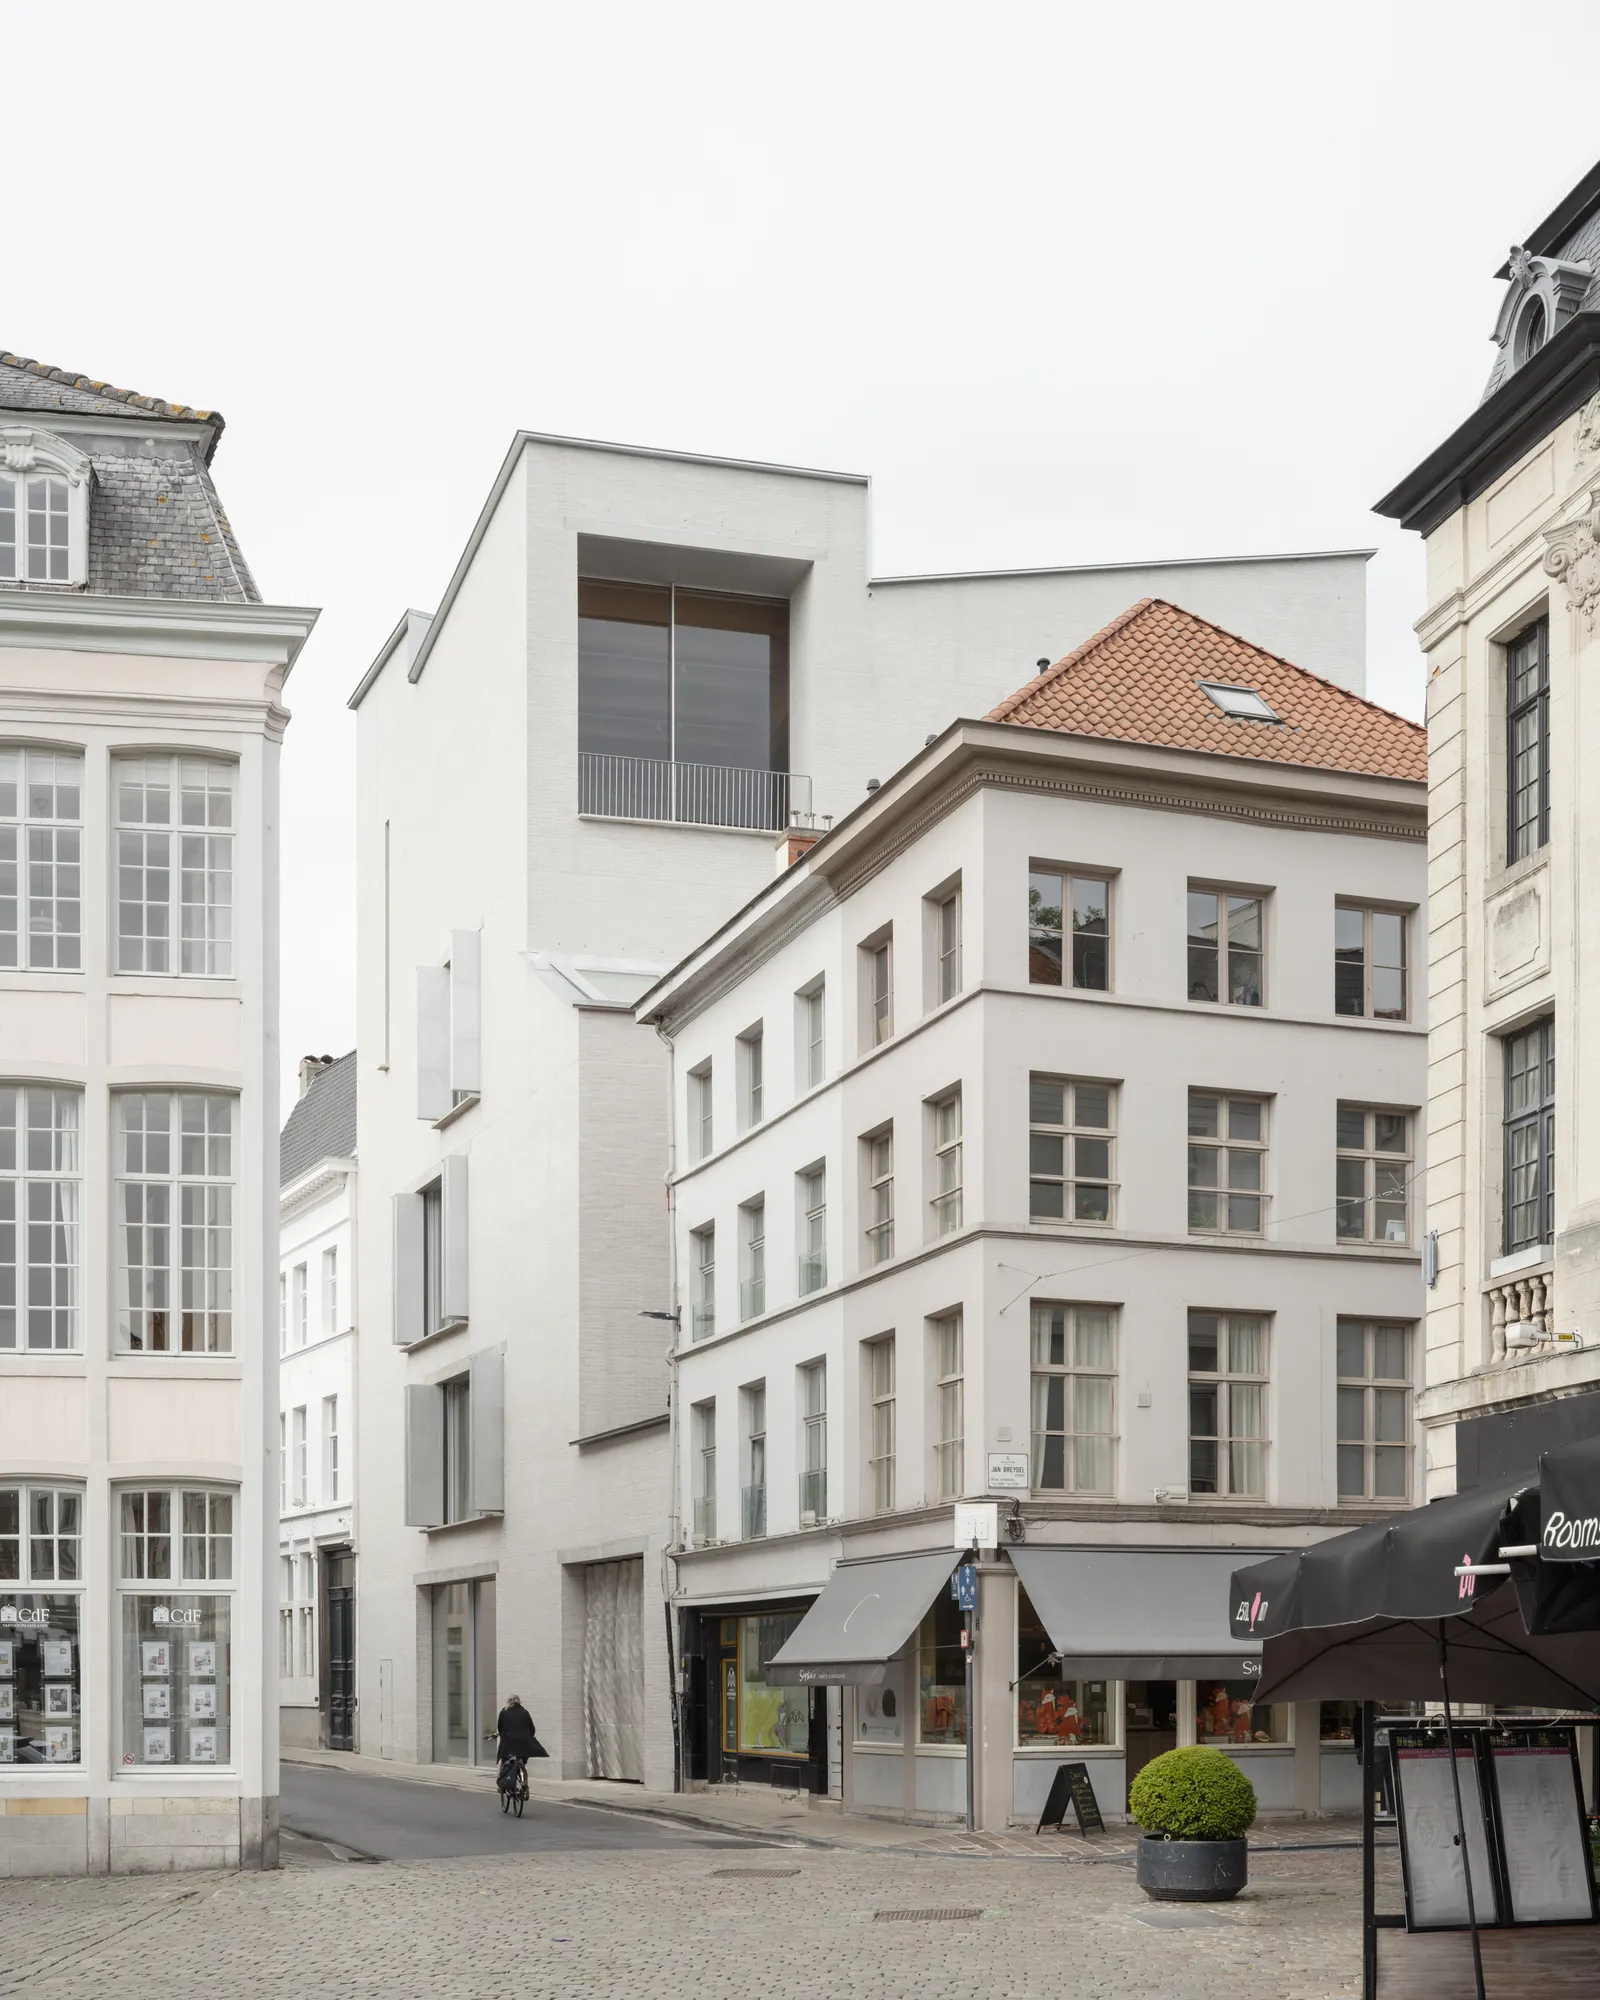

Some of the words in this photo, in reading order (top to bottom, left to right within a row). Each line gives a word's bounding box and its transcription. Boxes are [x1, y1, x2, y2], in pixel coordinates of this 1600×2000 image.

[1003, 1466, 1025, 1474] BREYDEL
[18, 1608, 50, 1622] CdF
[170, 1608, 202, 1623] CdF
